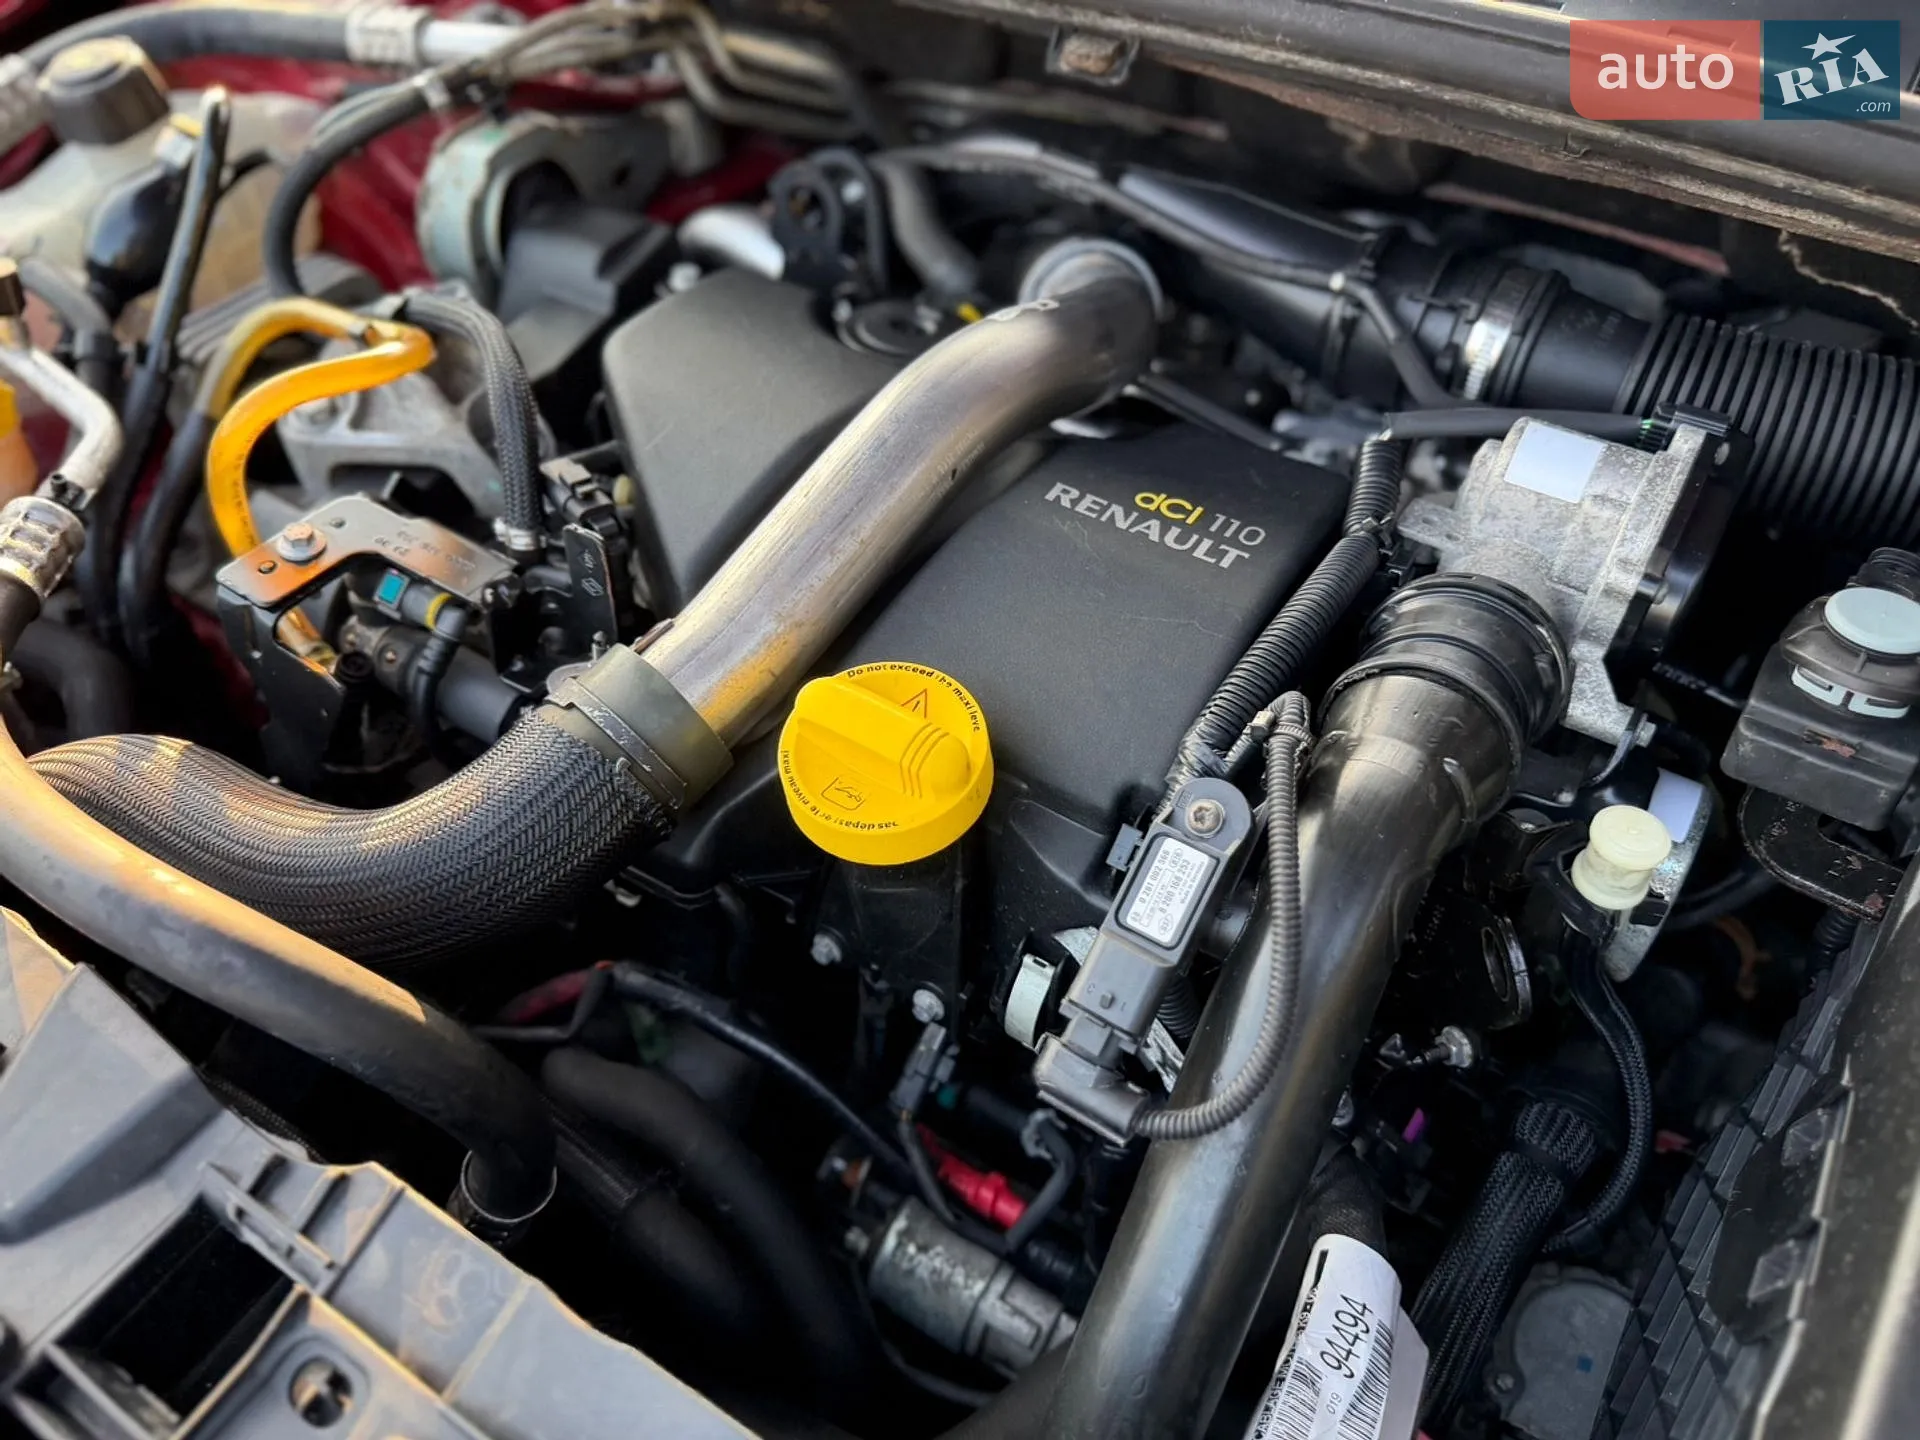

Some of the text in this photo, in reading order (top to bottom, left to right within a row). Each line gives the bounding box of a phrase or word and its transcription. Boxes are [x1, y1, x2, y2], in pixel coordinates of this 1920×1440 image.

[1044, 481, 1251, 569] RENAULT
[1209, 513, 1266, 546] 110
[847, 668, 863, 678] Do
[890, 664, 935, 678] exceed
[780, 750, 792, 775] maxi
[787, 776, 811, 806] niveau
[1319, 1294, 1374, 1380] 94494
[1327, 1391, 1344, 1415] 019
